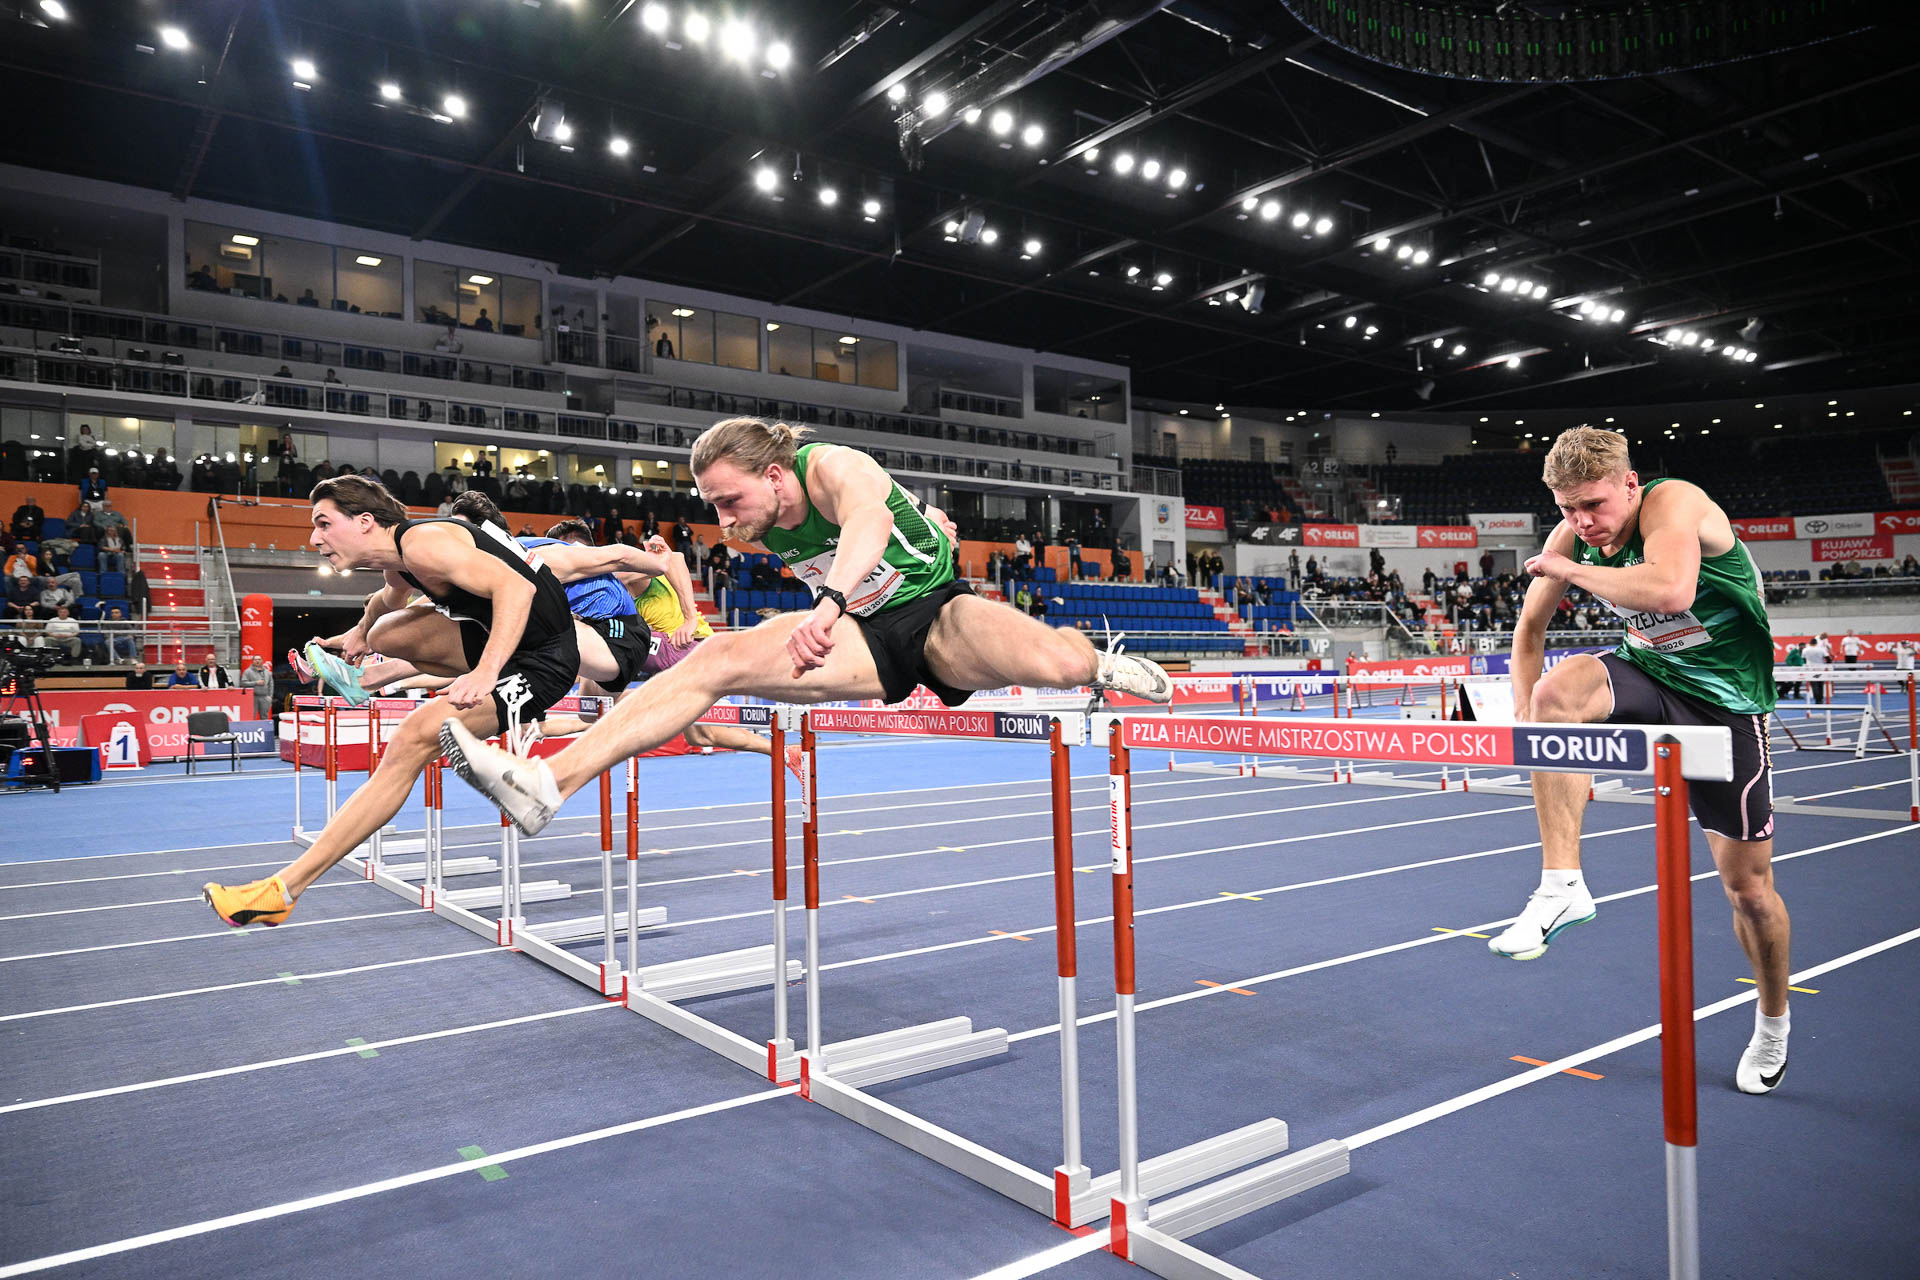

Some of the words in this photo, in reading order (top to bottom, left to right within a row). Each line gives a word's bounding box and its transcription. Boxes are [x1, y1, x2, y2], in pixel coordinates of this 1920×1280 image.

[1323, 461, 1339, 474] B2
[1488, 519, 1526, 529] polanik
[1748, 523, 1789, 534] ORLEN
[1252, 527, 1270, 540] 4F
[1278, 528, 1299, 541] 4F
[1324, 530, 1355, 540] ORLEN
[1439, 531, 1472, 541] ORLEN
[1821, 538, 1873, 549] KUJAWY
[1821, 547, 1884, 560] POMORZE
[870, 592, 889, 610] 2026
[1450, 639, 1467, 652] A1
[1478, 638, 1495, 651] B1
[1661, 640, 1685, 651] 2026
[1431, 664, 1466, 675] ORLEN
[713, 707, 737, 721] POLSKI
[742, 706, 767, 722] TORUŃ
[814, 713, 834, 727] PZLA
[835, 713, 876, 729] HALOWE
[877, 714, 947, 731] MISTRZOSTWA
[949, 715, 988, 733] POLSKI
[1000, 713, 1043, 735] TORUŃ
[116, 734, 129, 761] 1
[1132, 723, 1170, 743] PZLA
[1174, 725, 1253, 747] HALOWE
[1258, 727, 1406, 755] MISTRZOSTWA
[1412, 731, 1497, 758] POLSKI
[1527, 729, 1628, 763] TORUŃ
[1111, 799, 1121, 850] polanik
